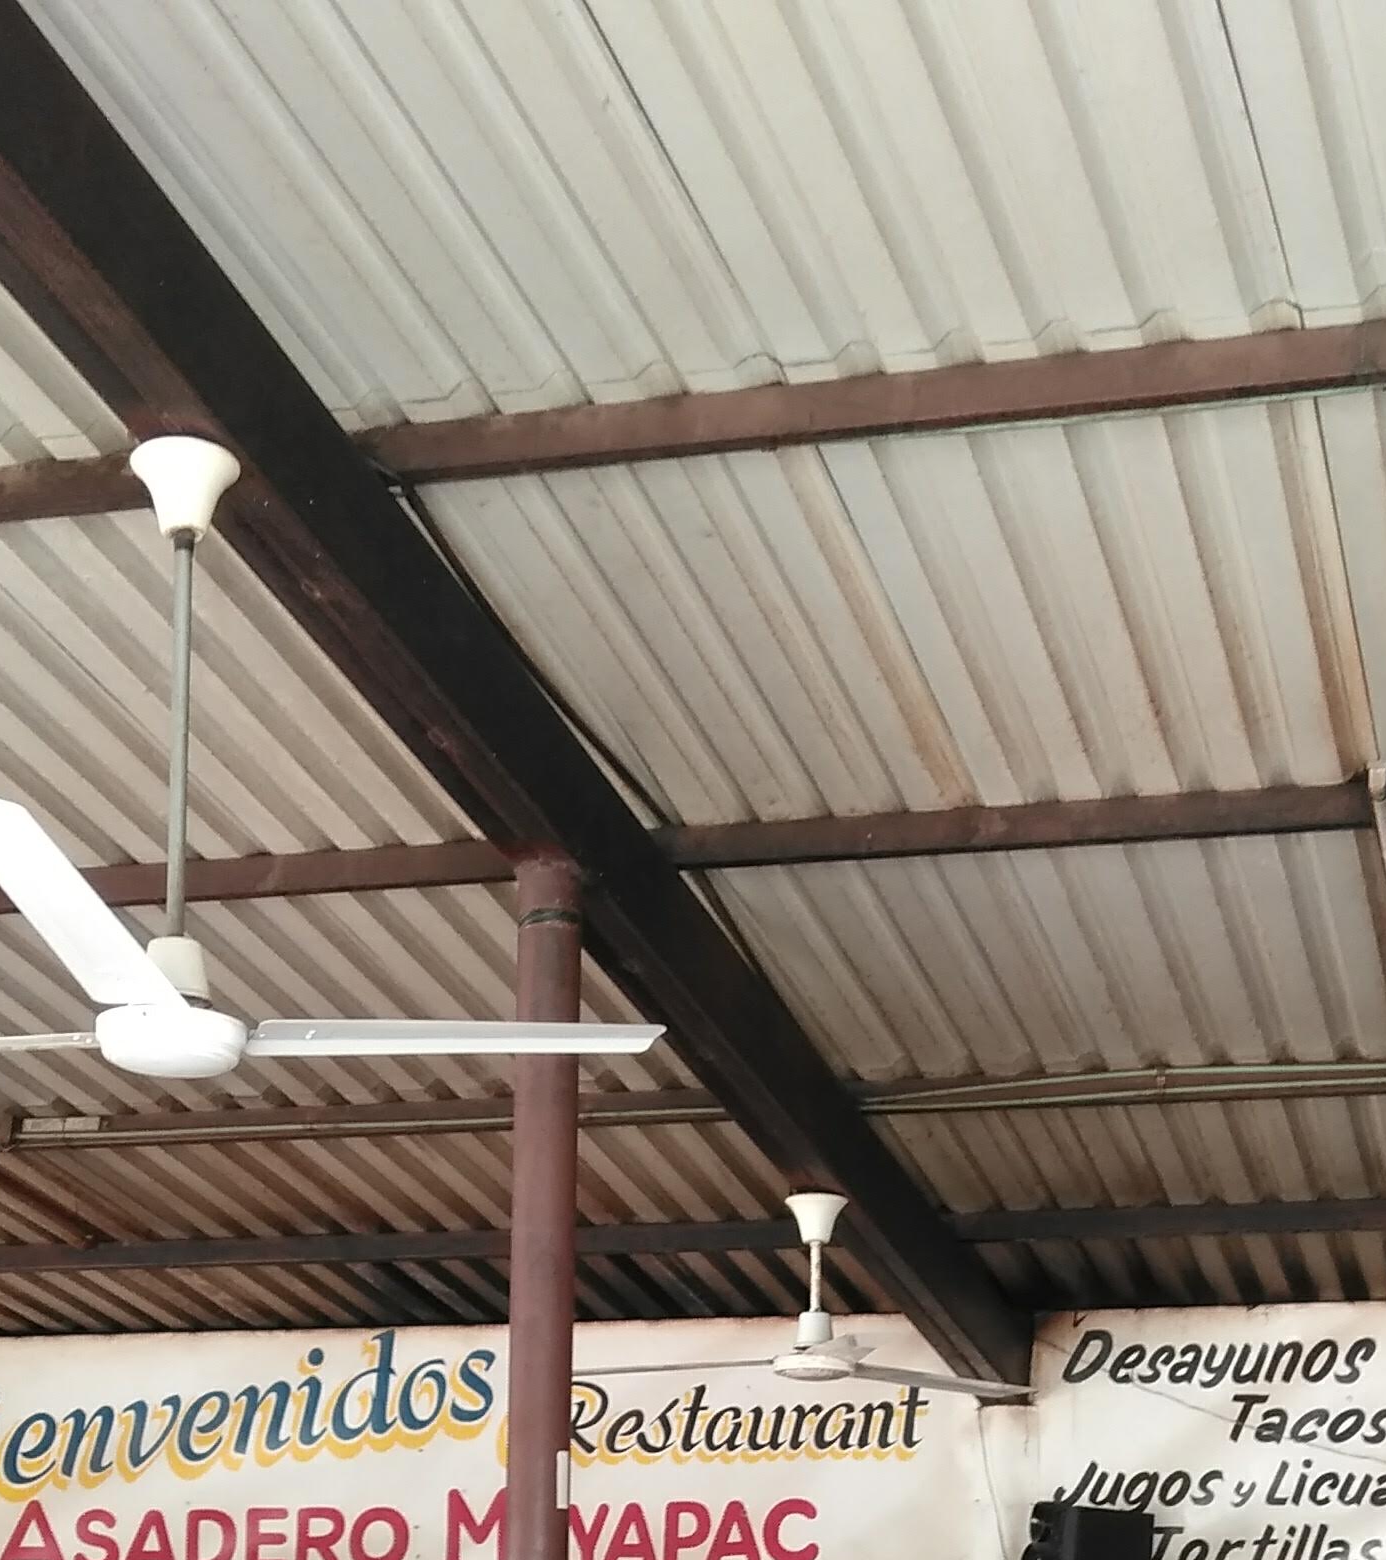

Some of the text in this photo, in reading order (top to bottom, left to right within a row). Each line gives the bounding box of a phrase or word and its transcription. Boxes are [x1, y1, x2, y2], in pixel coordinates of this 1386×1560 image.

[1062, 1328, 1377, 1389] Desayunos
[570, 1380, 931, 1456] Restaurant
[1053, 1459, 1224, 1511] Jugos
[1232, 1479, 1257, 1508] y
